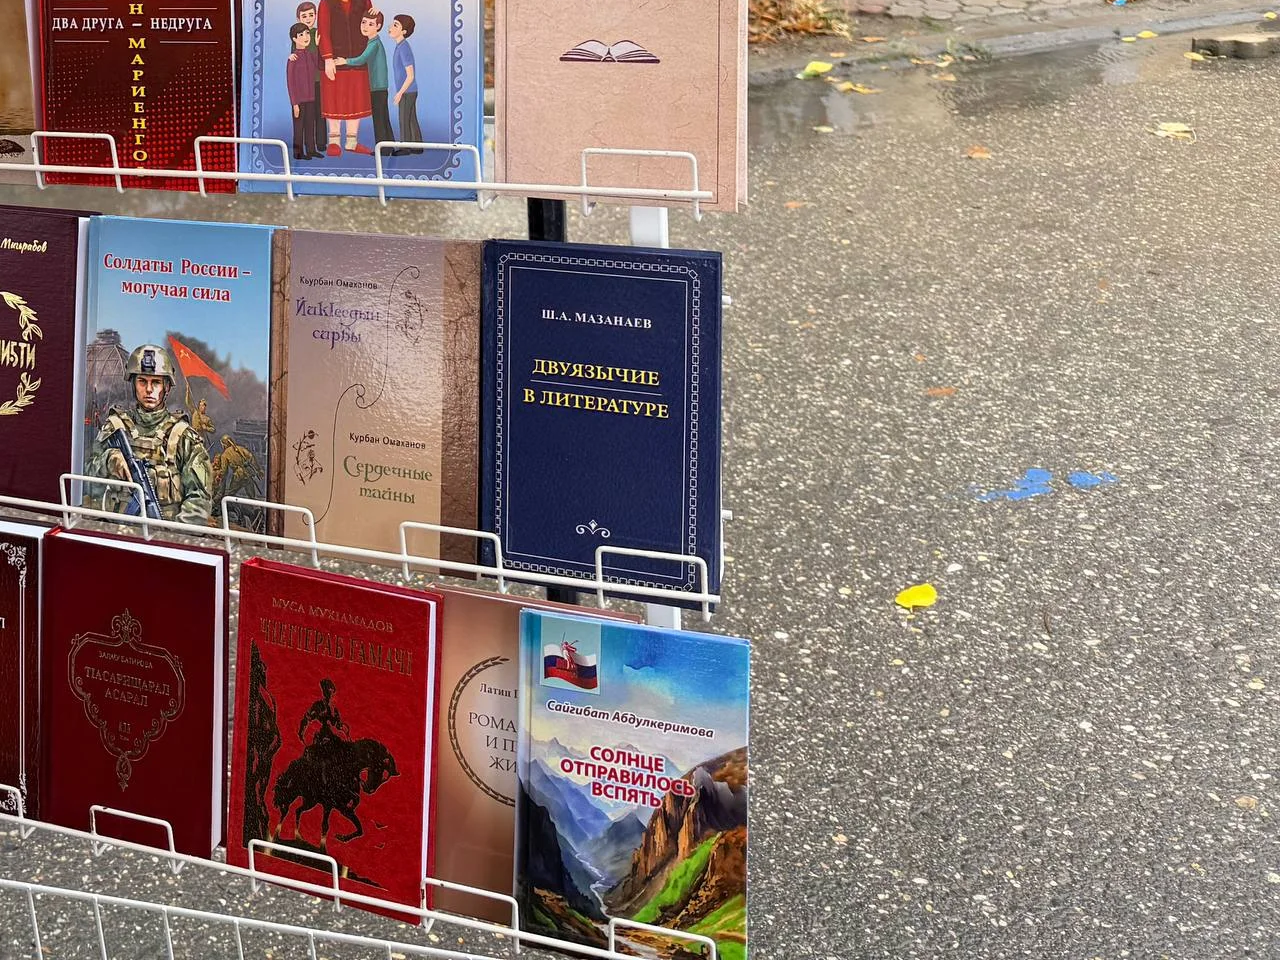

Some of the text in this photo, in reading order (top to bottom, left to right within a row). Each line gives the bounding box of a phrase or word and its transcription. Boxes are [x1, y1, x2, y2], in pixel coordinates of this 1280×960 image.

[52, 17, 212, 31] ДВА ДРУГА НЕДРУГА
[128, 37, 148, 177] МАРИЕНГО
[104, 253, 238, 278] Солдаты России
[122, 281, 231, 302] могучая сила
[541, 309, 652, 329] Ш.А. МАЗАНАЕВ
[532, 359, 660, 386] ДВУЯЗЫЧИЕ
[523, 388, 669, 419] В ЛИТЕРАТУРЕ
[349, 432, 426, 450] Курбан Омаханов
[343, 454, 433, 483] Сердечные
[359, 485, 415, 504] тайны
[272, 597, 305, 614] МУСА
[104, 688, 149, 707] АСАРАЛ
[469, 711, 517, 733] РОМА
[547, 700, 714, 739] Сайгибат Абдулкеримова
[486, 735, 498, 749] И
[589, 746, 665, 774] СОЛНЦЕ
[560, 758, 696, 797] ОТПРАВИЛОСЬ
[591, 782, 662, 809] ВСПЯТЬ
